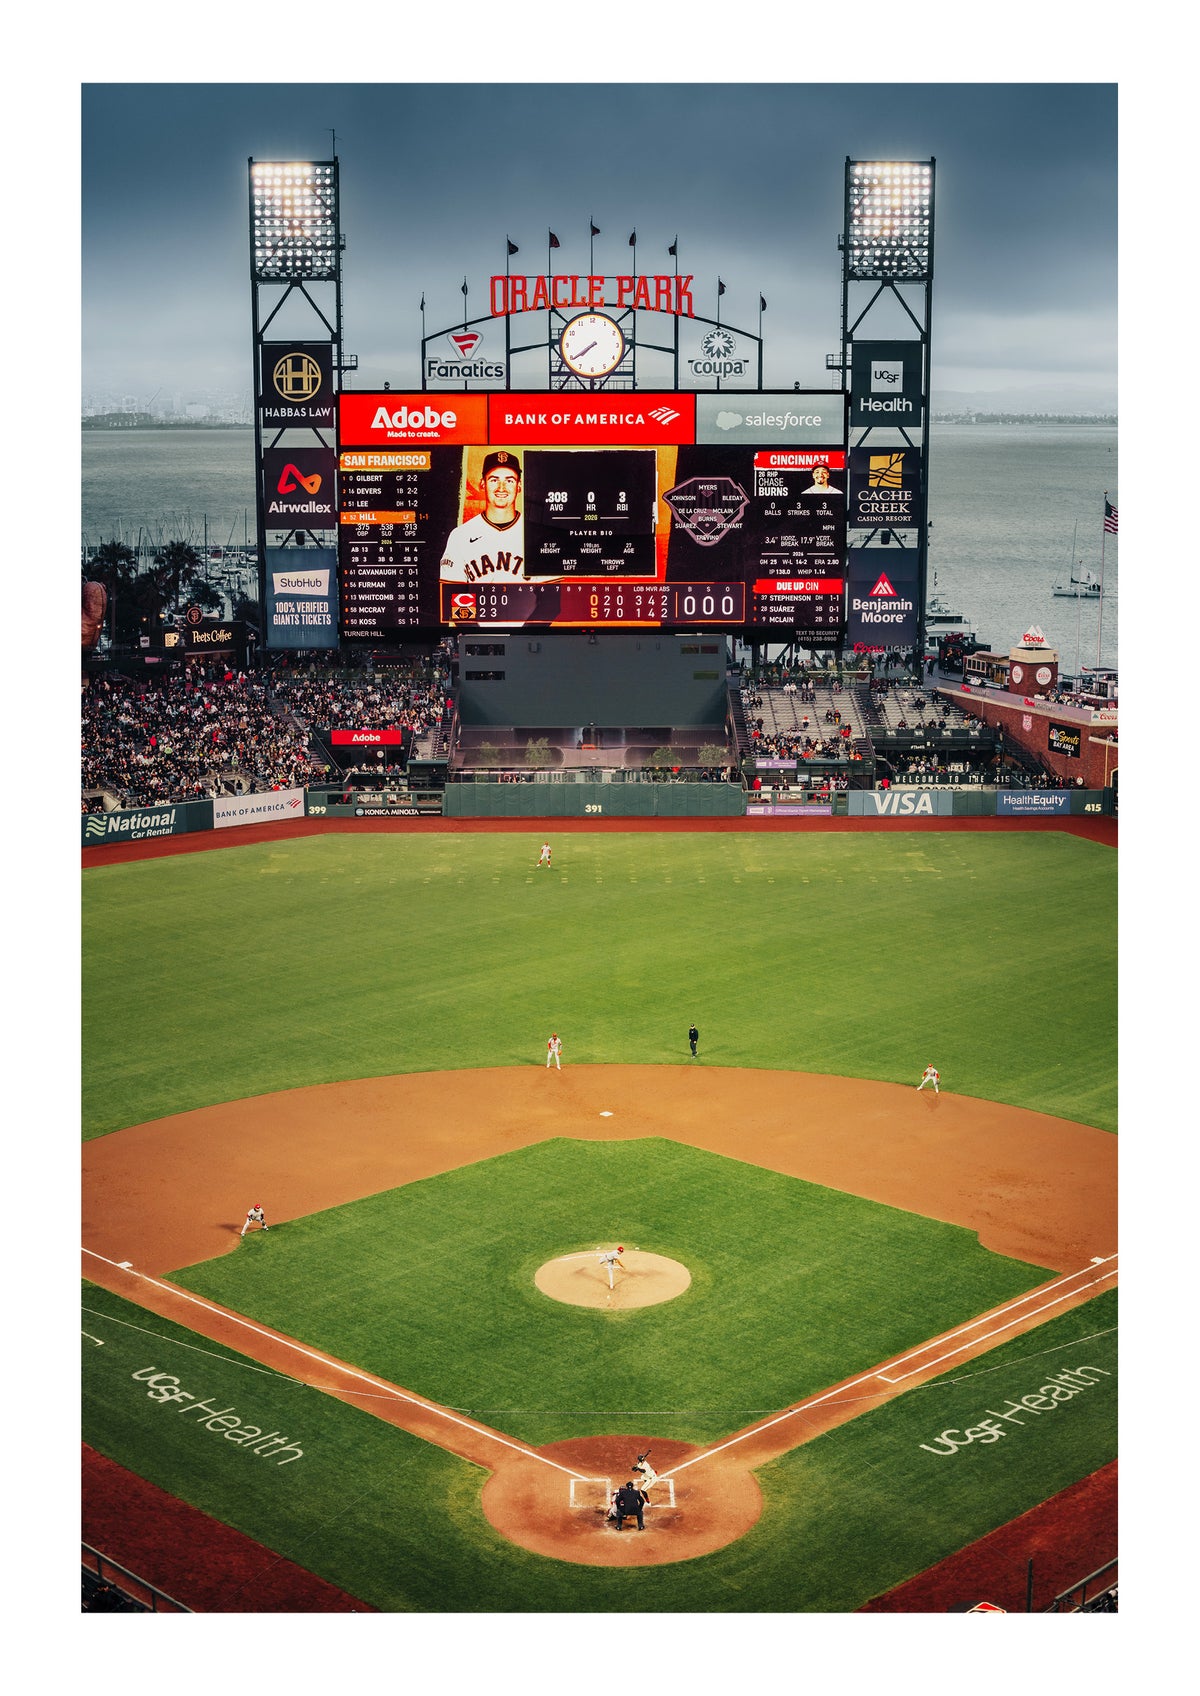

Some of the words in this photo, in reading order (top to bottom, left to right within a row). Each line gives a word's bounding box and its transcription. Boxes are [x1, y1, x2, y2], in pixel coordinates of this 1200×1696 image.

[490, 276, 604, 317] ORACLE
[616, 276, 695, 318] PARK
[428, 360, 504, 378] Fanatics
[693, 360, 743, 377] coupa
[874, 371, 899, 383] UCSF
[861, 398, 912, 412] Health
[266, 408, 306, 417] HABBAS
[309, 408, 330, 416] LAW
[371, 406, 456, 429] Adobe
[505, 414, 547, 424] BANK
[552, 414, 571, 424] OF
[575, 414, 645, 424] AMERICA
[746, 412, 822, 430] salesforce
[344, 456, 365, 466] SAN
[368, 456, 426, 466] FRANCISCO
[770, 455, 828, 465] CINCINNATI
[759, 478, 783, 486] CHASE
[759, 487, 788, 496] BURNS
[858, 491, 912, 501] CACHE
[546, 492, 567, 503] .308
[588, 492, 595, 503] 0
[619, 492, 626, 503] 3
[269, 501, 331, 513] Airwallex
[859, 503, 910, 513] CREEK
[280, 578, 322, 588] StubHub
[777, 582, 792, 590] DUE
[794, 582, 804, 590] UP
[806, 582, 818, 590] CIN
[480, 595, 486, 605] 0
[490, 595, 496, 605] 0
[501, 595, 508, 605] 0
[590, 595, 598, 606] 0
[604, 595, 610, 606] 2
[617, 595, 623, 606] 0
[635, 595, 642, 606] 3
[648, 595, 655, 606] 4
[661, 595, 668, 606] 2
[684, 596, 695, 615] 0
[703, 596, 714, 615] 0
[722, 596, 733, 615] 0
[853, 598, 912, 612] Benjamin
[276, 602, 295, 613] 100%
[297, 602, 328, 613] VERIFIED
[480, 608, 486, 618] 2
[490, 608, 497, 618] 3
[591, 608, 598, 618] 5
[604, 608, 610, 618] 7
[617, 608, 623, 618] 0
[636, 608, 641, 618] 1
[648, 608, 655, 618] 4
[661, 608, 668, 618] 2
[273, 614, 300, 625] GIANTS
[301, 614, 331, 625] TICKETS
[861, 612, 903, 623] Moore
[211, 629, 232, 642] Coffee
[1024, 634, 1044, 642] Coors
[853, 642, 884, 653] Coors
[352, 732, 380, 742] Adobe
[1058, 731, 1079, 745] Sports
[868, 793, 933, 814] VISA
[1003, 795, 1064, 806] HealthEquity
[216, 809, 237, 819] BANK
[239, 807, 249, 816] OF
[250, 804, 285, 814] AMERICA
[309, 806, 327, 814] 399
[585, 804, 602, 813] 391
[108, 809, 175, 833] National
[132, 830, 145, 839] Car
[147, 826, 173, 837] Rental
[131, 1366, 196, 1403] UCSF
[178, 1398, 303, 1466] Health
[919, 1419, 1007, 1456] UCSF
[985, 1366, 1112, 1426] Health
